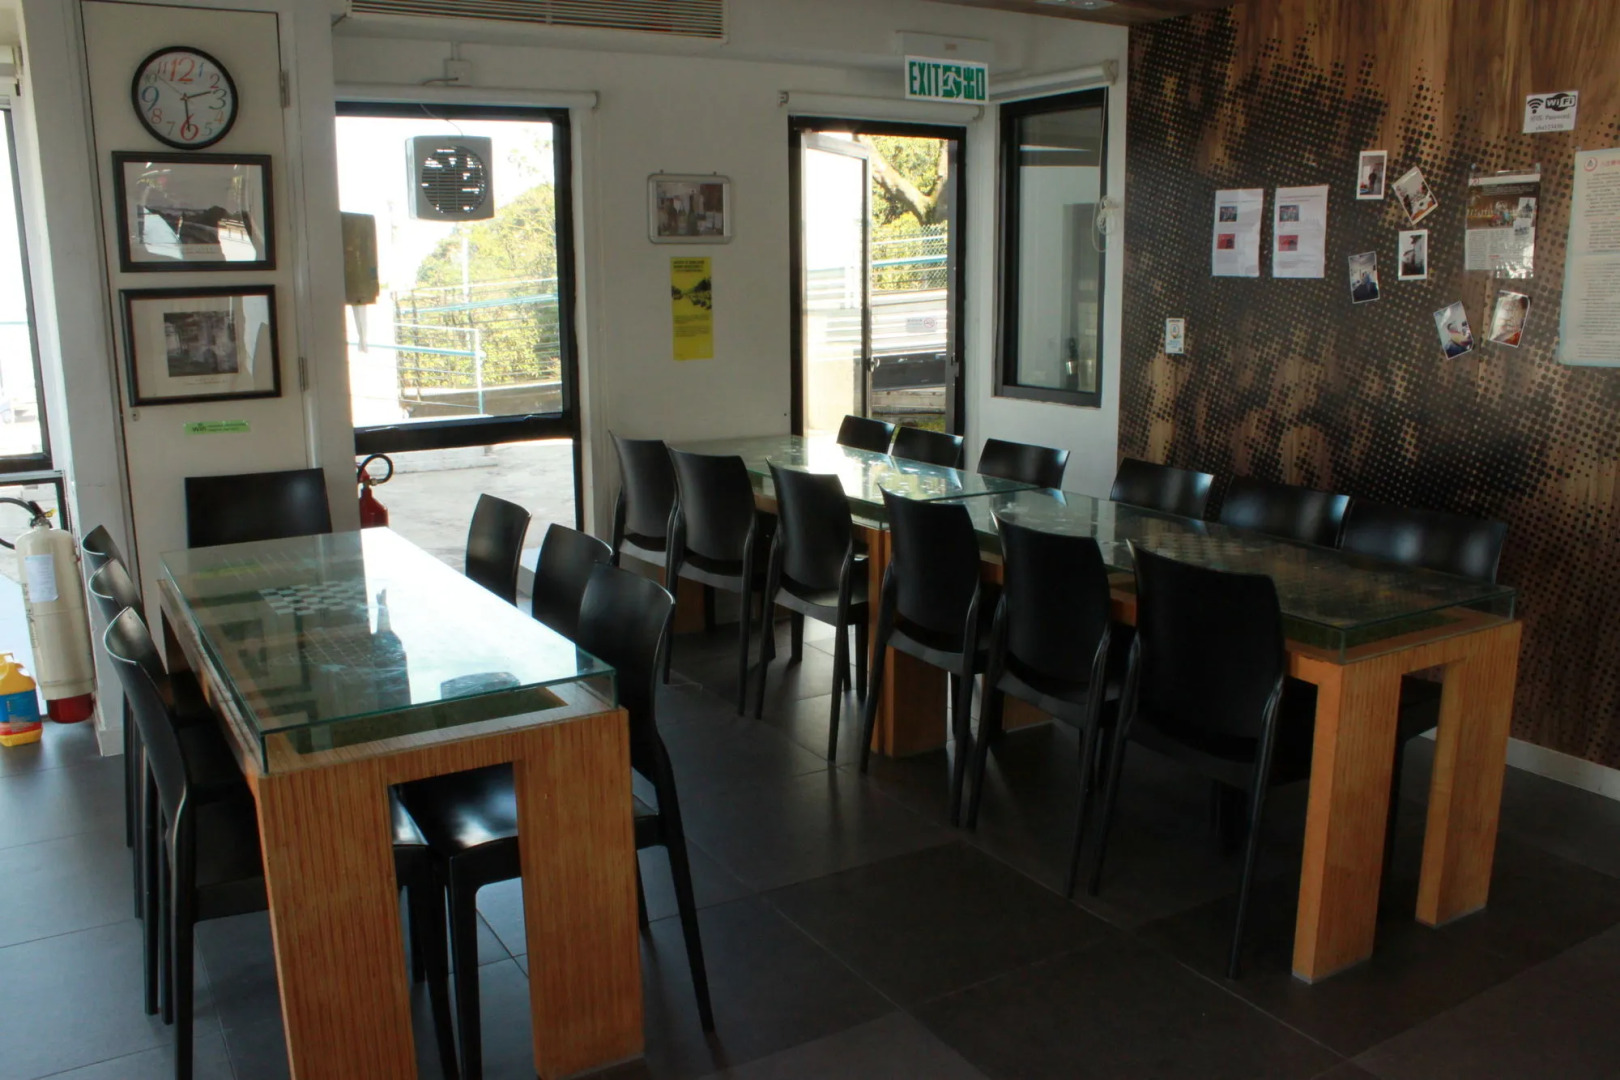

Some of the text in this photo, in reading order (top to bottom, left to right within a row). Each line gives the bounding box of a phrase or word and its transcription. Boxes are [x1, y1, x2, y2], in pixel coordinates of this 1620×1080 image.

[157, 61, 168, 74] 11
[169, 57, 195, 82] 12
[198, 63, 204, 78] 1
[210, 74, 220, 88] 2
[909, 62, 940, 97] EXIT
[964, 67, 985, 100] 出口
[142, 86, 159, 111] 9
[209, 89, 226, 109] 3
[151, 108, 162, 124] 8
[214, 111, 225, 124] 4
[166, 121, 176, 136] 7
[180, 113, 199, 141] 6
[204, 122, 213, 136] 5
